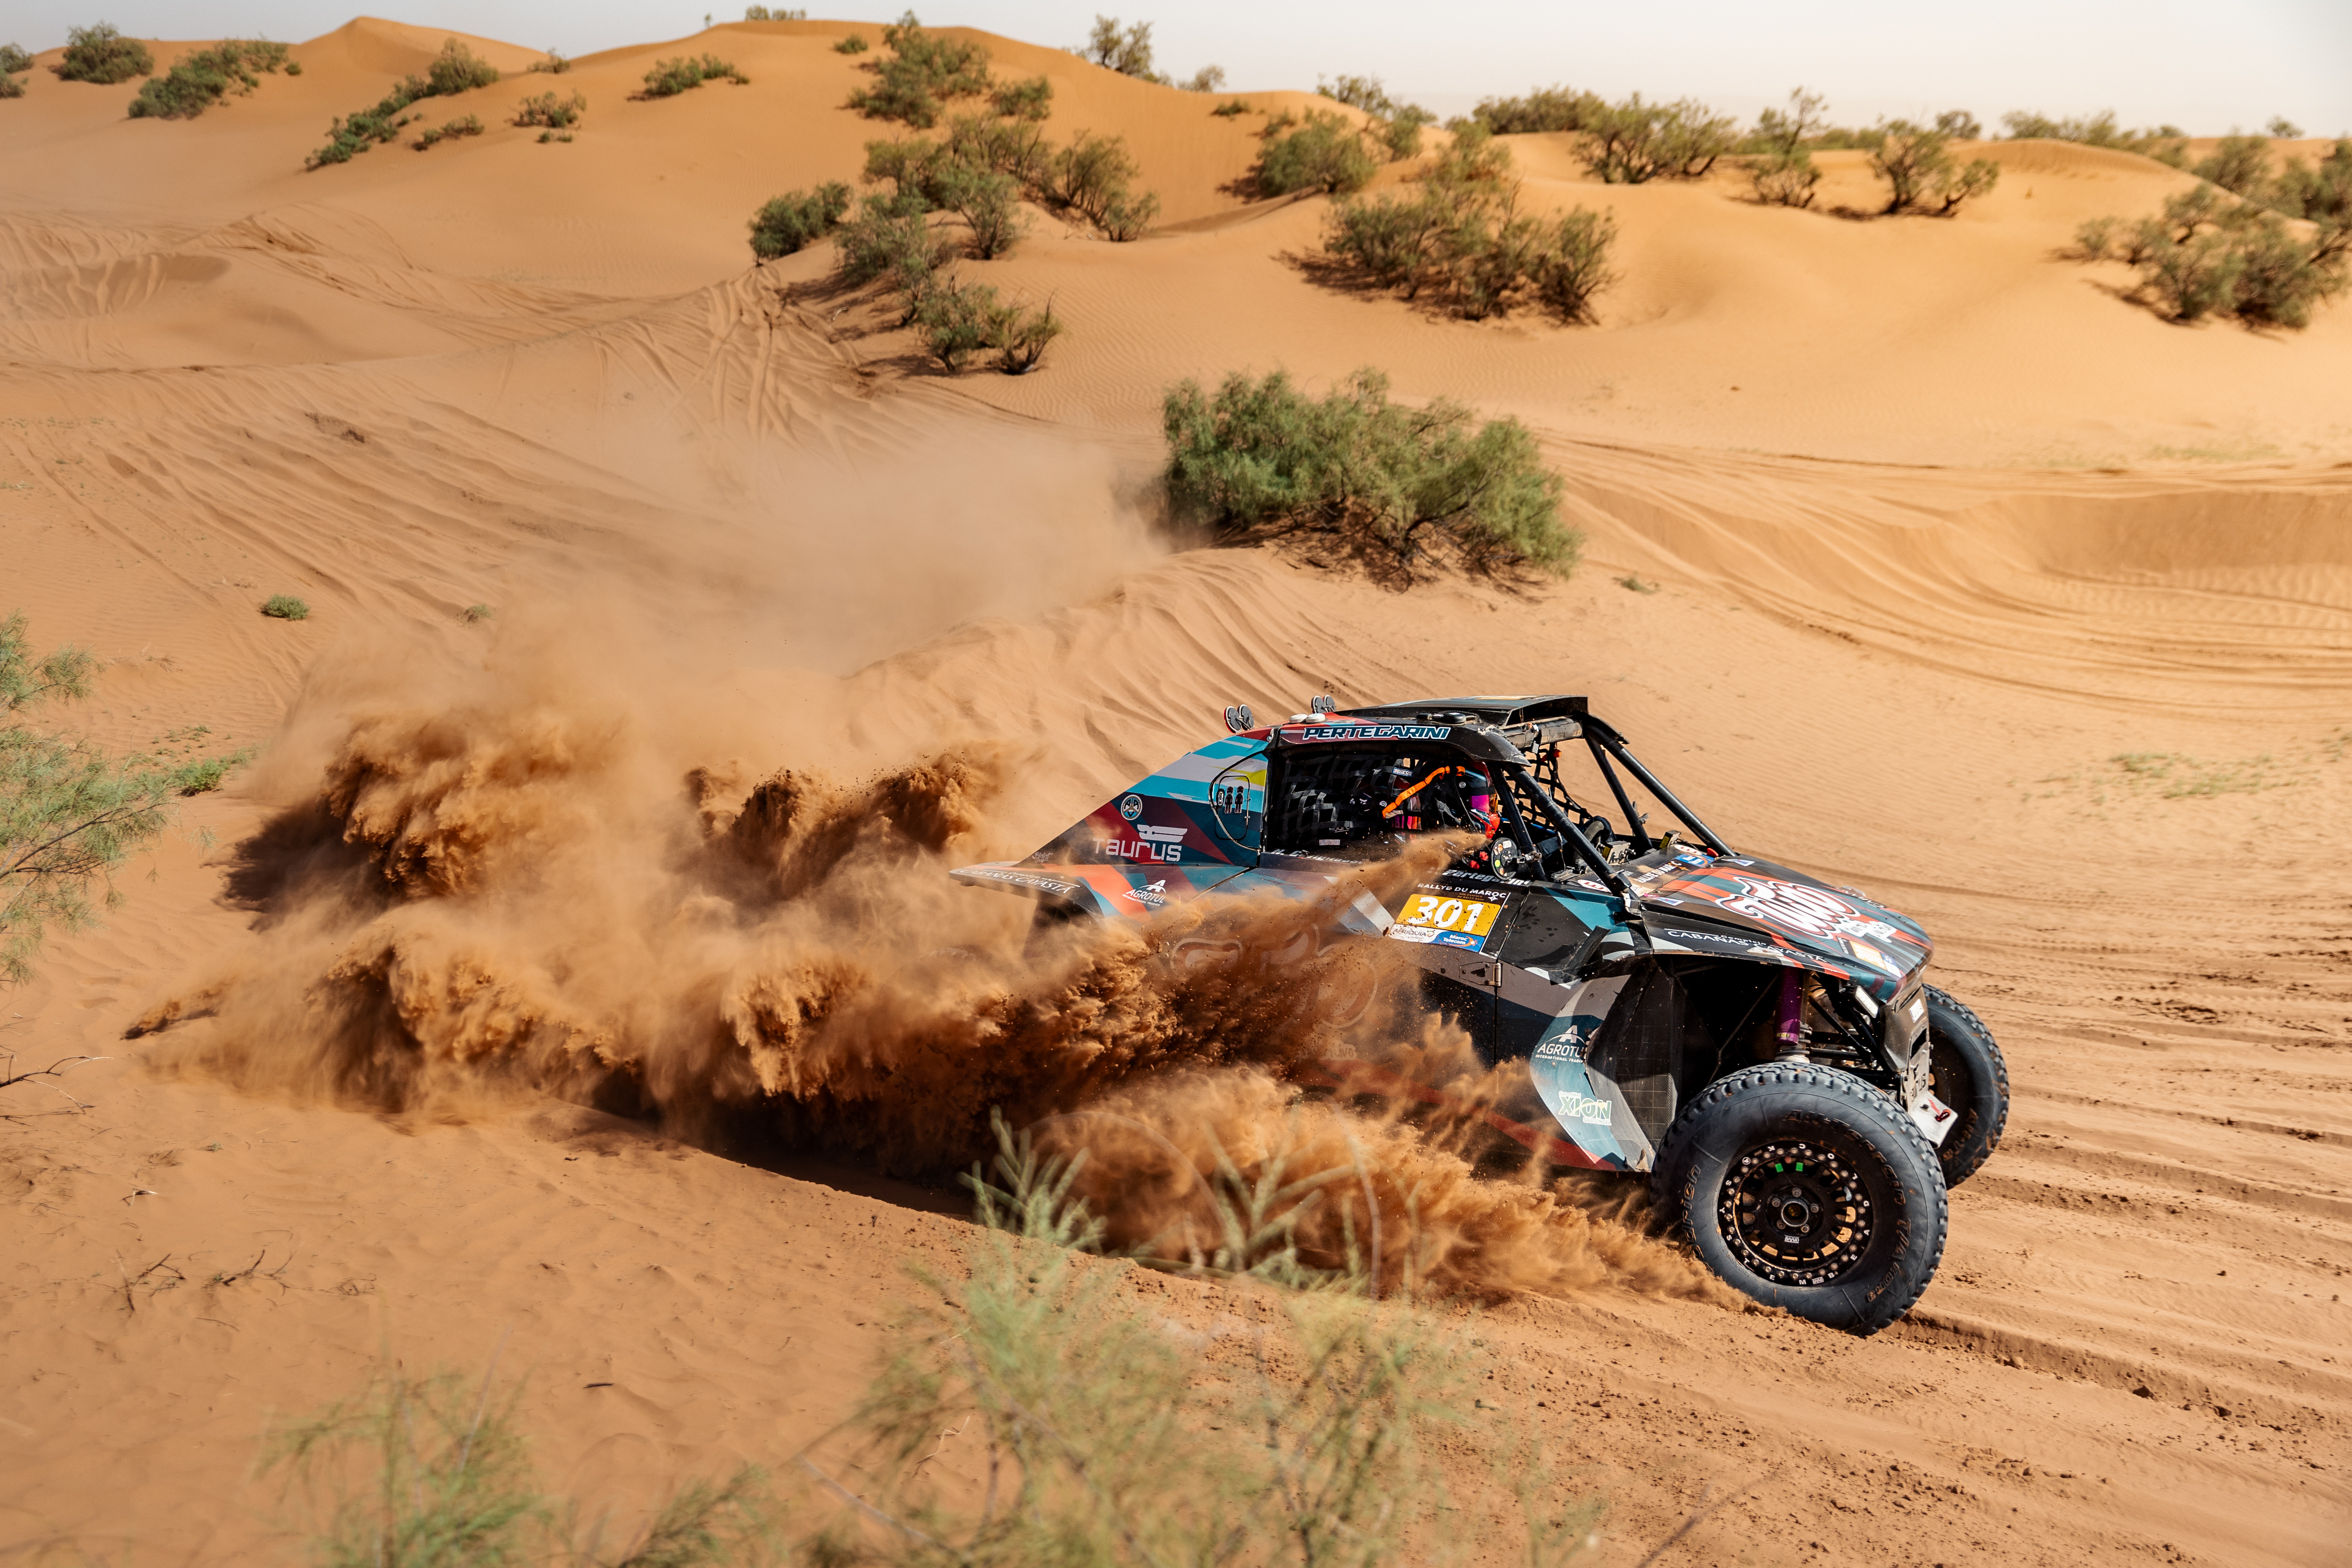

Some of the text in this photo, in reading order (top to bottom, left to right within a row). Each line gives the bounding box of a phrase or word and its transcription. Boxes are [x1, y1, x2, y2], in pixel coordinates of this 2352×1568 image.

[1302, 726, 1451, 740] PERTEGARINI
[1417, 883, 1453, 891] RALLYE
[1469, 889, 1506, 898] MAROC
[1407, 897, 1484, 932] 301
[1394, 928, 1426, 937] AFRIQUIA
[1537, 1043, 1585, 1058] AGROTU
[1558, 1096, 1612, 1120] XION
[1784, 1235, 1800, 1243] BRAID
